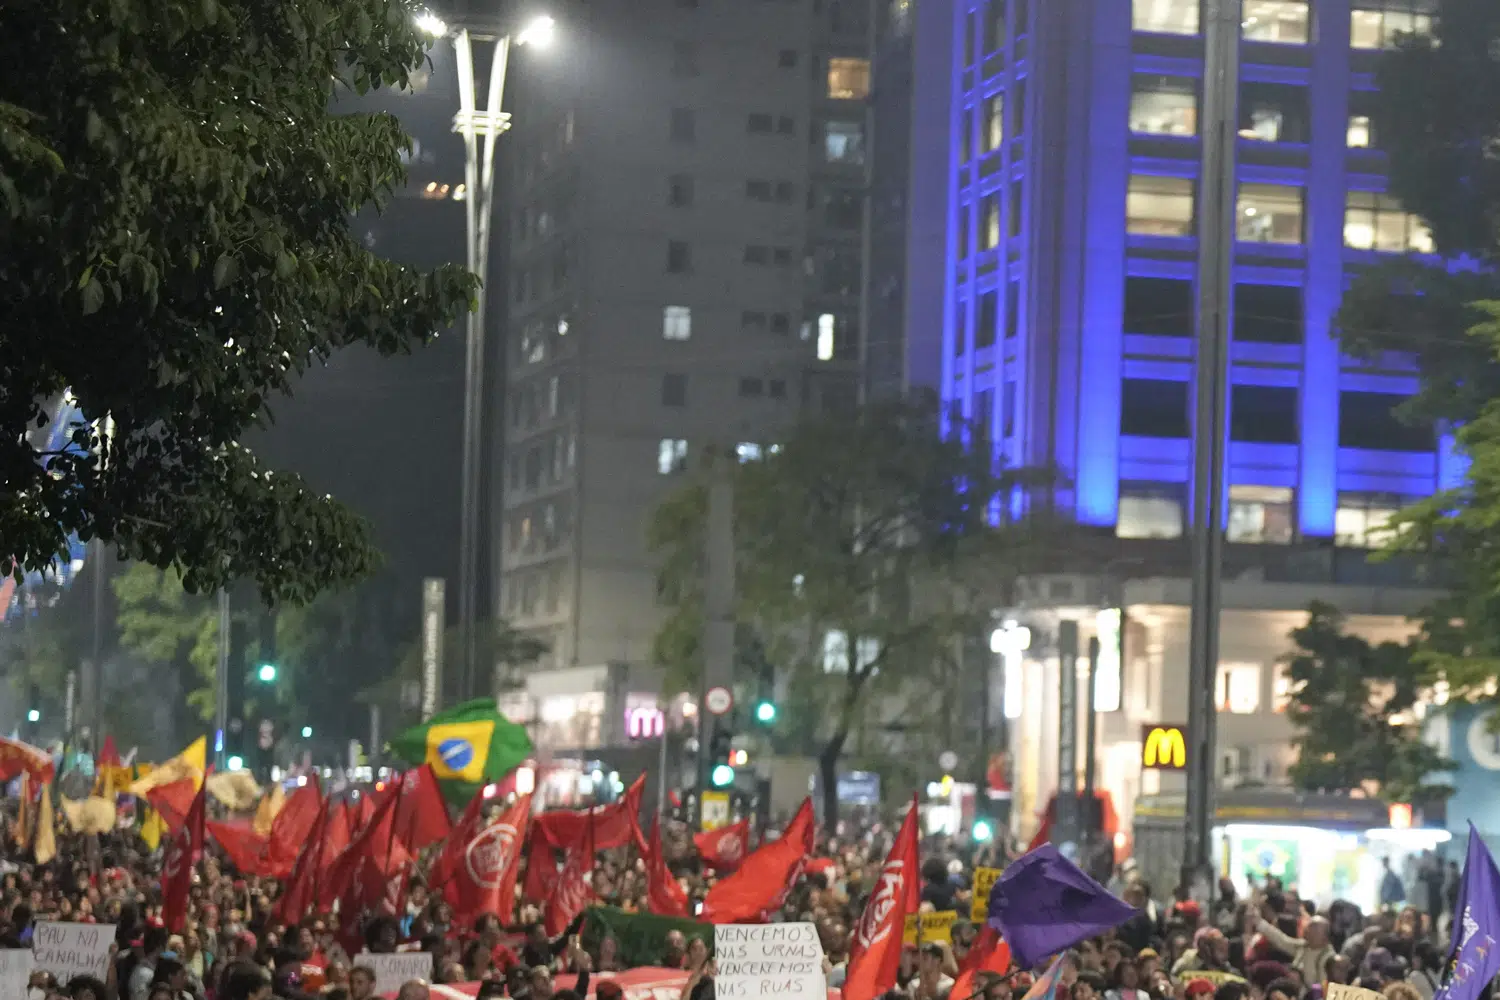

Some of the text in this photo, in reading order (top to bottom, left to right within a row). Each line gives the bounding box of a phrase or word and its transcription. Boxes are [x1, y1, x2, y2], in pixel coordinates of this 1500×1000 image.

[77, 930, 99, 949] NA
[716, 926, 815, 942] VENCEMOS
[716, 944, 818, 959] NAS URNAS
[717, 961, 813, 976] VENCEREMOS
[718, 979, 803, 997] NAS RUAS
